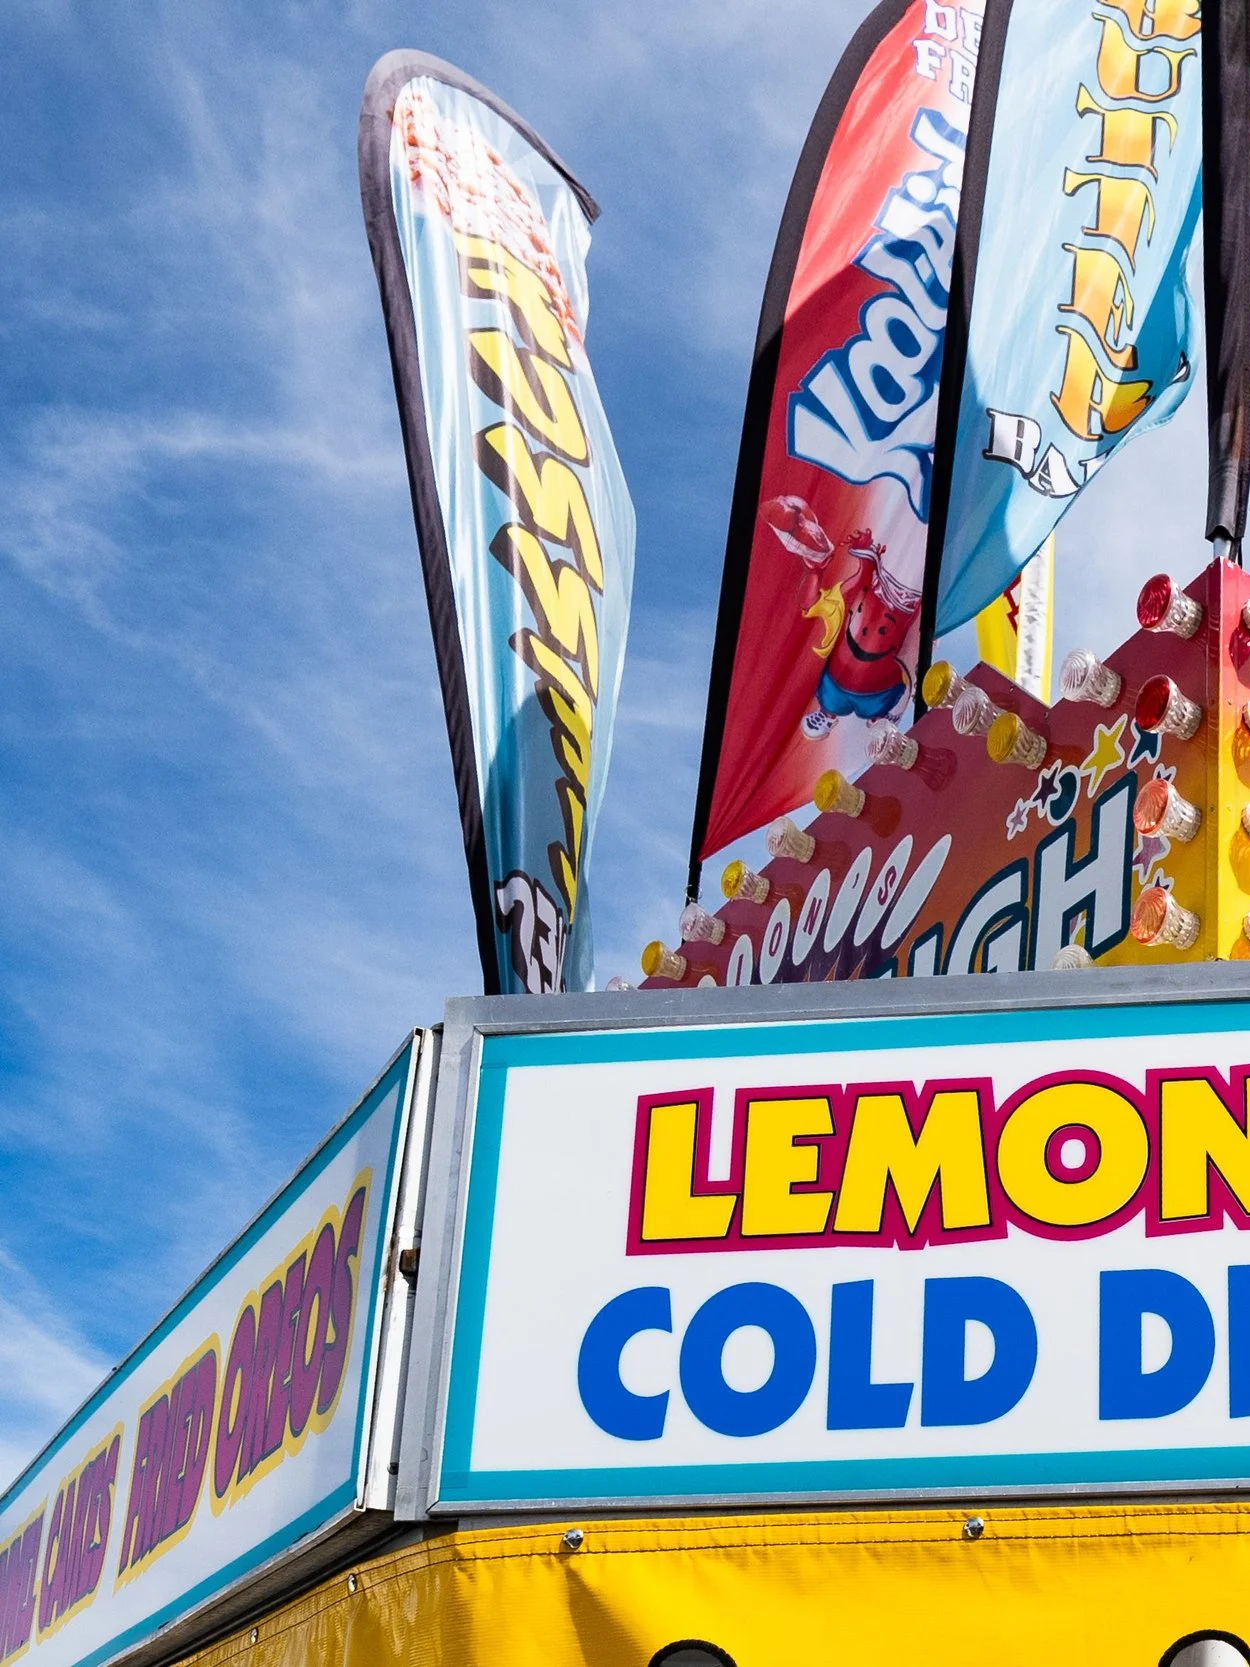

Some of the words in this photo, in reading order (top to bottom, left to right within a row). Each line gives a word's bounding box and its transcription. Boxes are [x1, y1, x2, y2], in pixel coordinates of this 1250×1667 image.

[37, 1434, 121, 1633] CAKES
[117, 1347, 218, 1577] FRIED
[213, 1185, 367, 1499] OREOS
[577, 1275, 1038, 1441] COLD
